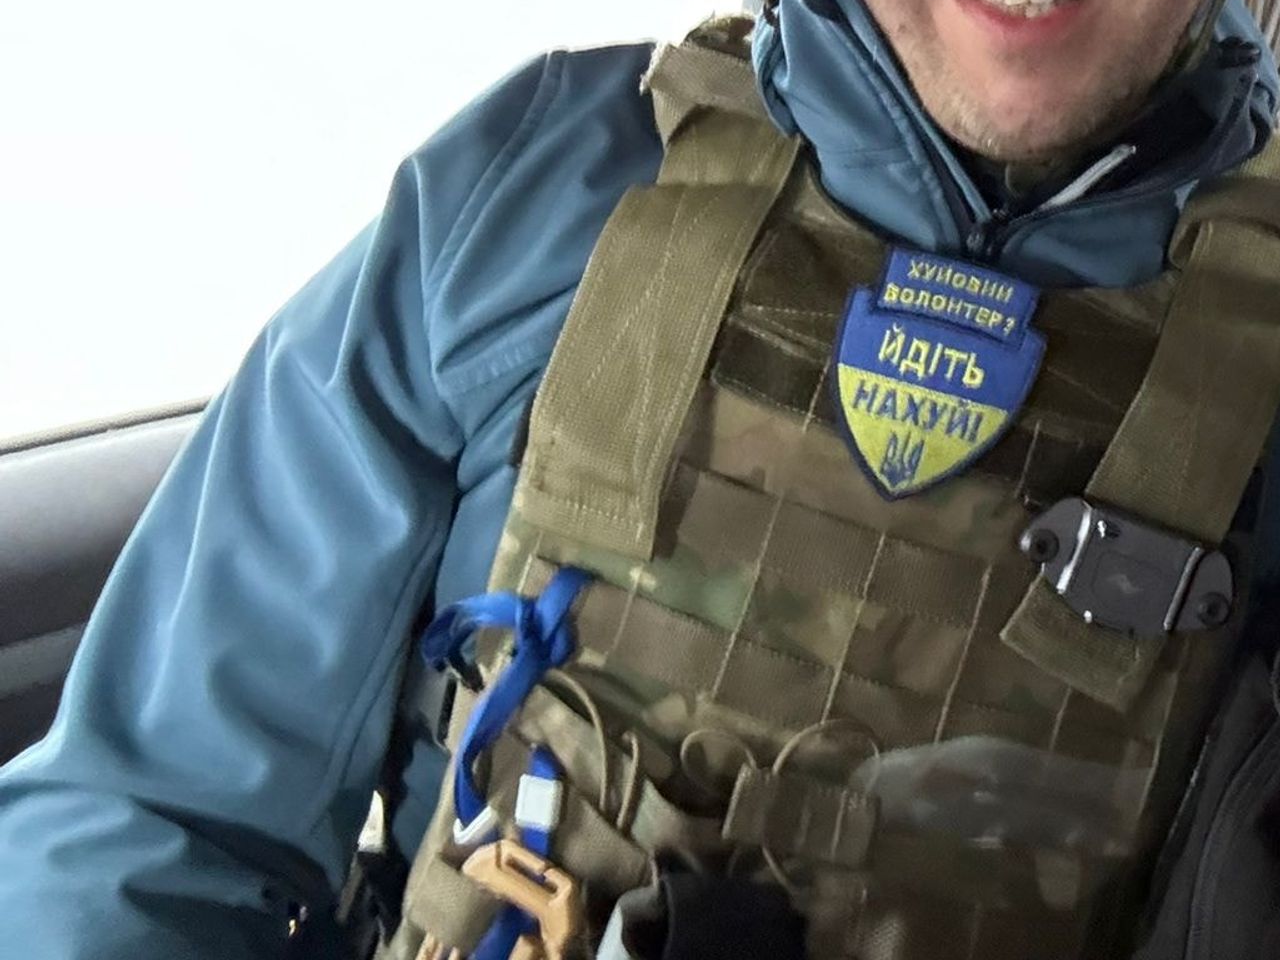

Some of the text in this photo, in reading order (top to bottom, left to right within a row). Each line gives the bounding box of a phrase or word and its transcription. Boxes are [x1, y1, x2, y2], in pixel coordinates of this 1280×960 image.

[883, 282, 1016, 337] ВОЛОНТЕР?
[878, 323, 985, 389] ЙДІТЬ
[852, 378, 984, 442] НАХУЙ!
